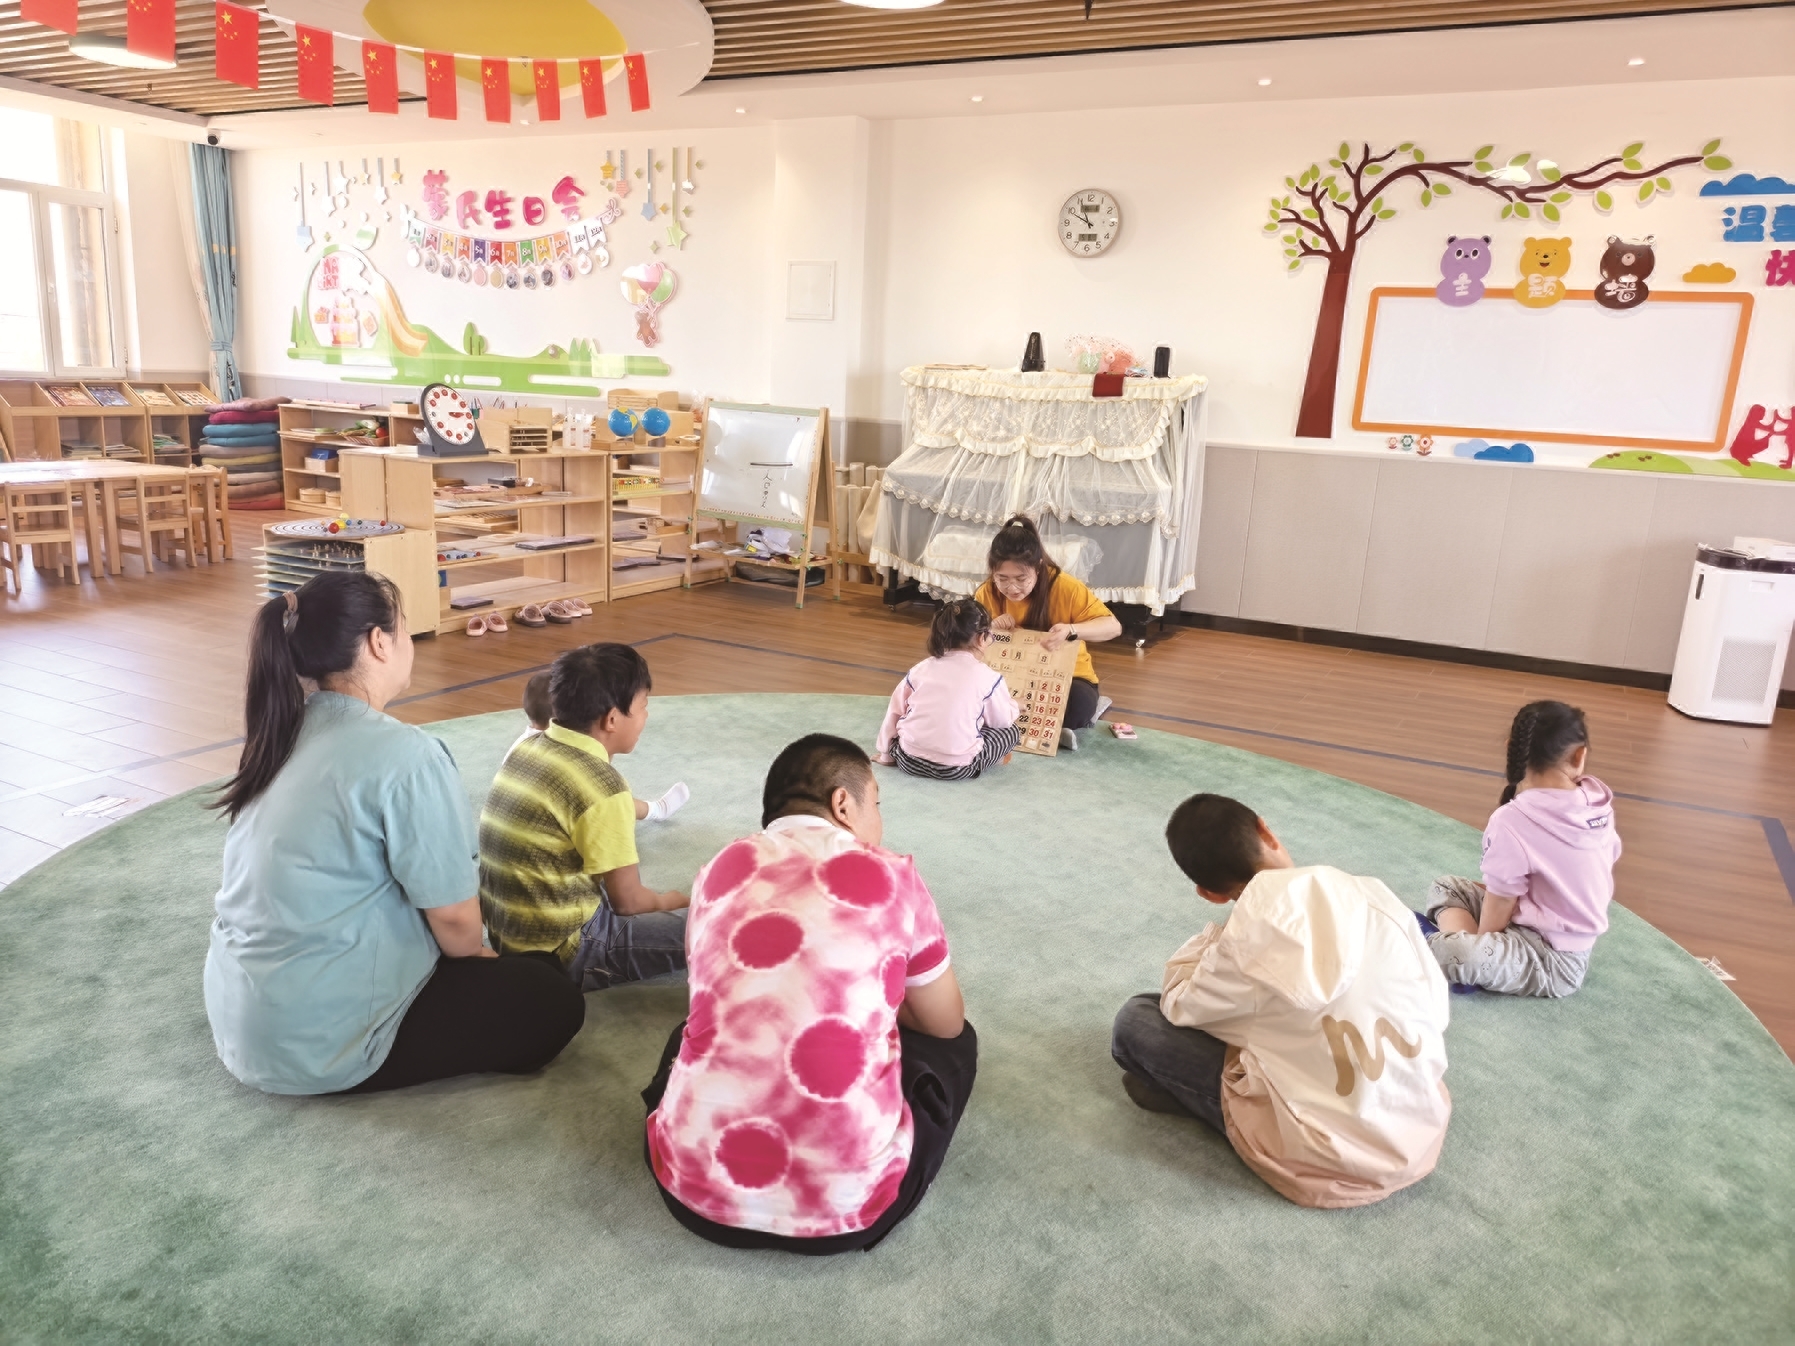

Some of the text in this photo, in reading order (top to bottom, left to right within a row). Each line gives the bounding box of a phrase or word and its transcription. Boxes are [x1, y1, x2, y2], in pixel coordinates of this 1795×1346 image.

[422, 169, 585, 230] 蒙氏生日会
[1088, 194, 1096, 202] 12
[1068, 206, 1076, 214] 10
[1106, 206, 1113, 214] 2
[1072, 241, 1079, 250] 7
[1084, 244, 1090, 252] 6
[1096, 241, 1102, 249] 5
[1001, 648, 1007, 658] 5
[1051, 695, 1061, 704] 10
[1035, 705, 1044, 714] 16
[1049, 707, 1058, 715] 17
[1032, 717, 1042, 725] 23
[1045, 719, 1056, 728] 24
[1029, 728, 1040, 737] 30
[1044, 730, 1053, 739] 31
